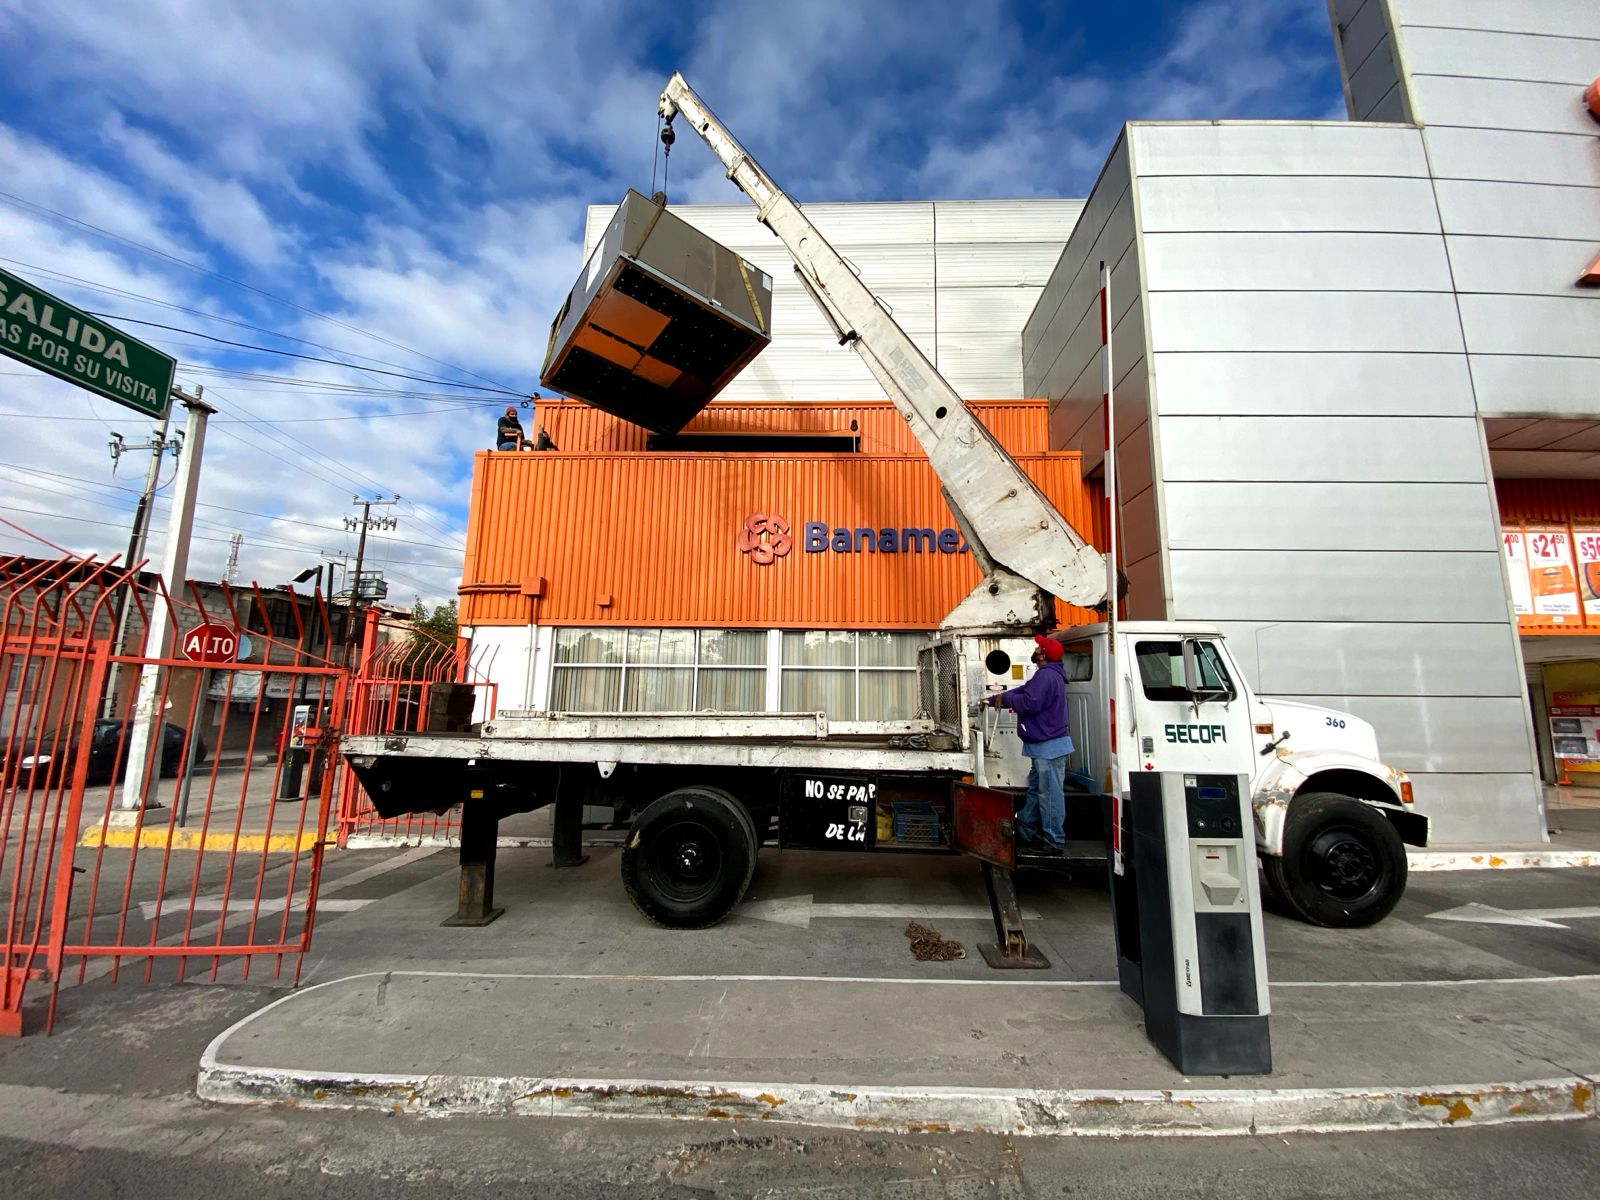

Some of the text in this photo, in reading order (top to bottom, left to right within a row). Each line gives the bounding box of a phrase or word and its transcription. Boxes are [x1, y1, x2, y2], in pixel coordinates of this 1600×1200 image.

[27, 332, 70, 366] POR
[73, 353, 101, 379] SU
[105, 368, 158, 405] VISITA
[805, 521, 970, 554] Baname
[1325, 716, 1346, 730] 360
[1164, 724, 1227, 744] SECOFI
[805, 779, 824, 799] NO
[826, 784, 846, 800] SE
[825, 823, 845, 841] DE
